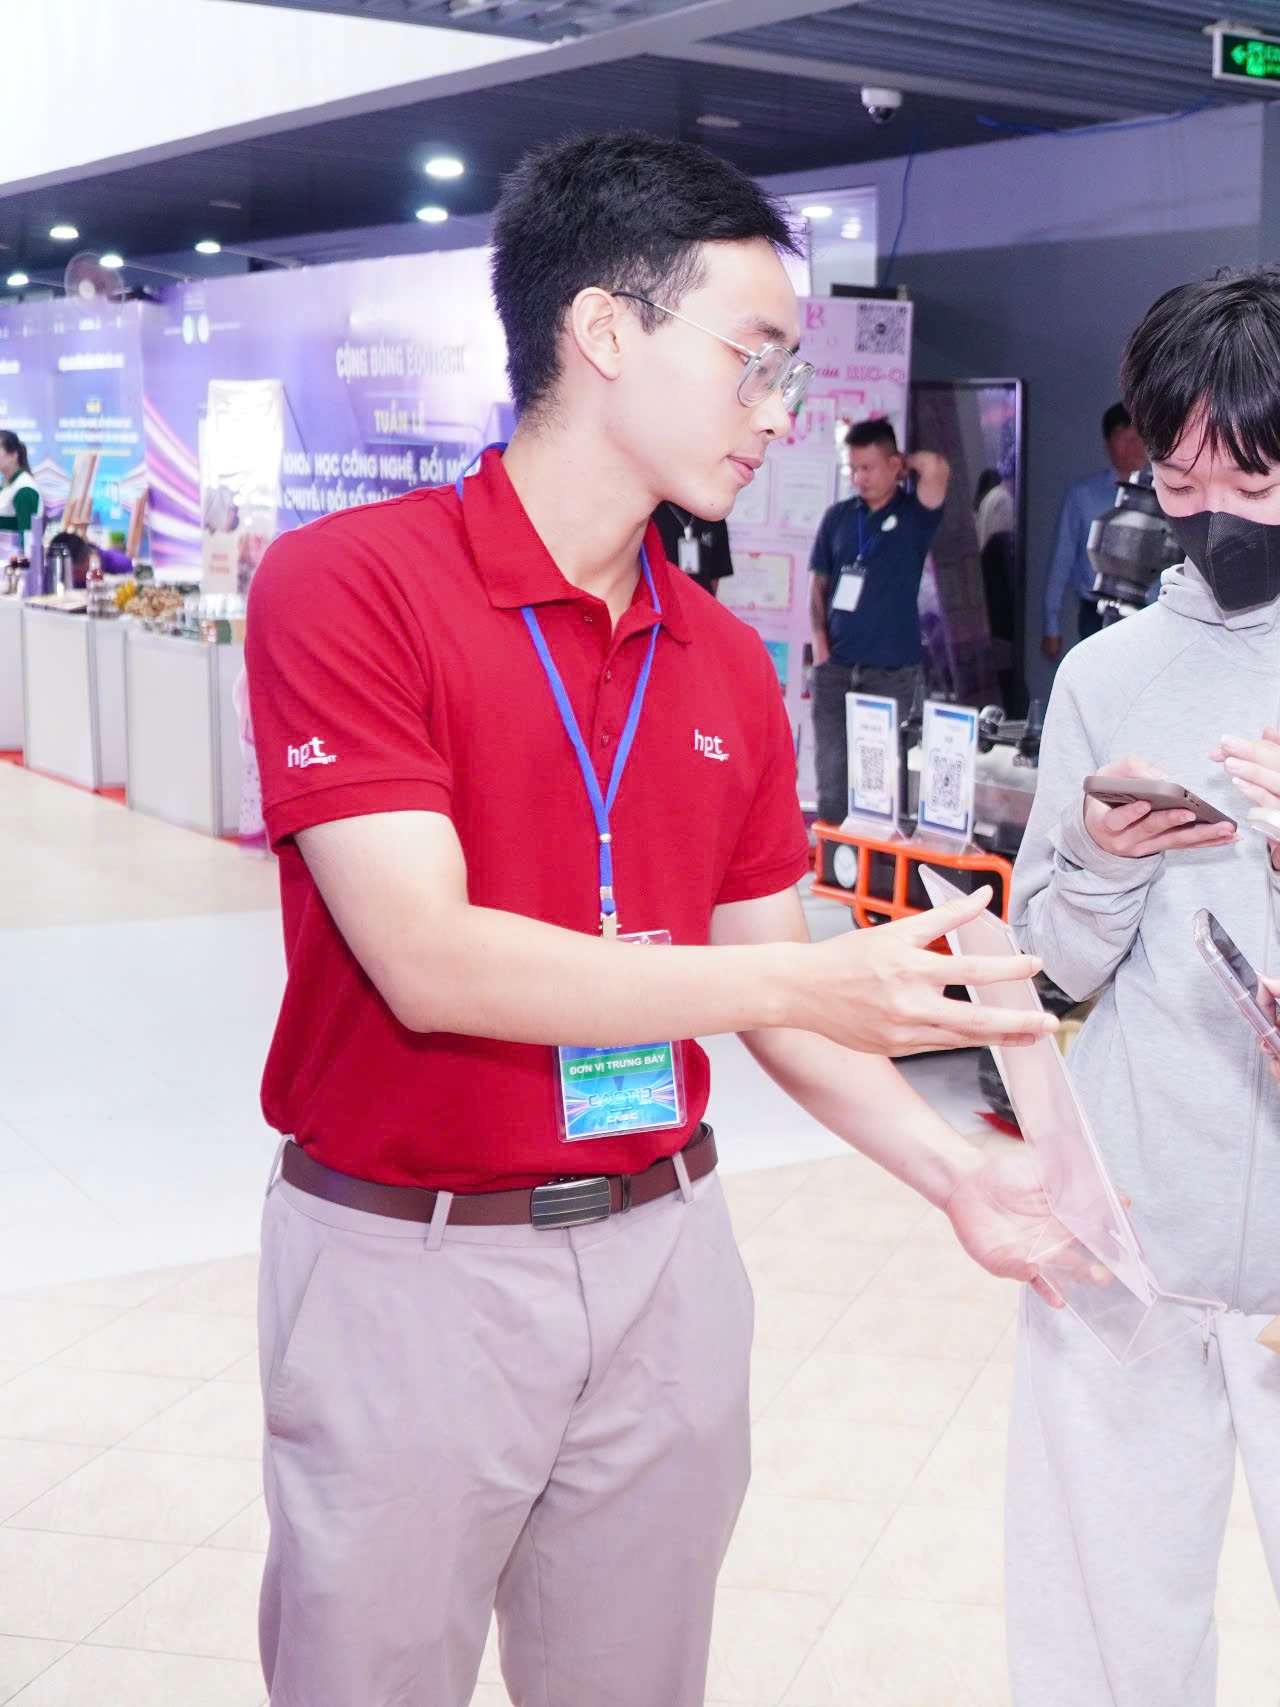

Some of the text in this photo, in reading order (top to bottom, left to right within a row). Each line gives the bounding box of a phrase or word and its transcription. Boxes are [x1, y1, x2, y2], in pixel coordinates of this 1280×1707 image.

[314, 452, 339, 481] HỌC
[342, 448, 377, 478] CÔNG
[420, 447, 444, 483] ĐỔI
[287, 736, 327, 768] hpt
[694, 728, 724, 757] hpt
[569, 1052, 666, 1076] ĐƠN VỊ TRƯNG BÀY
